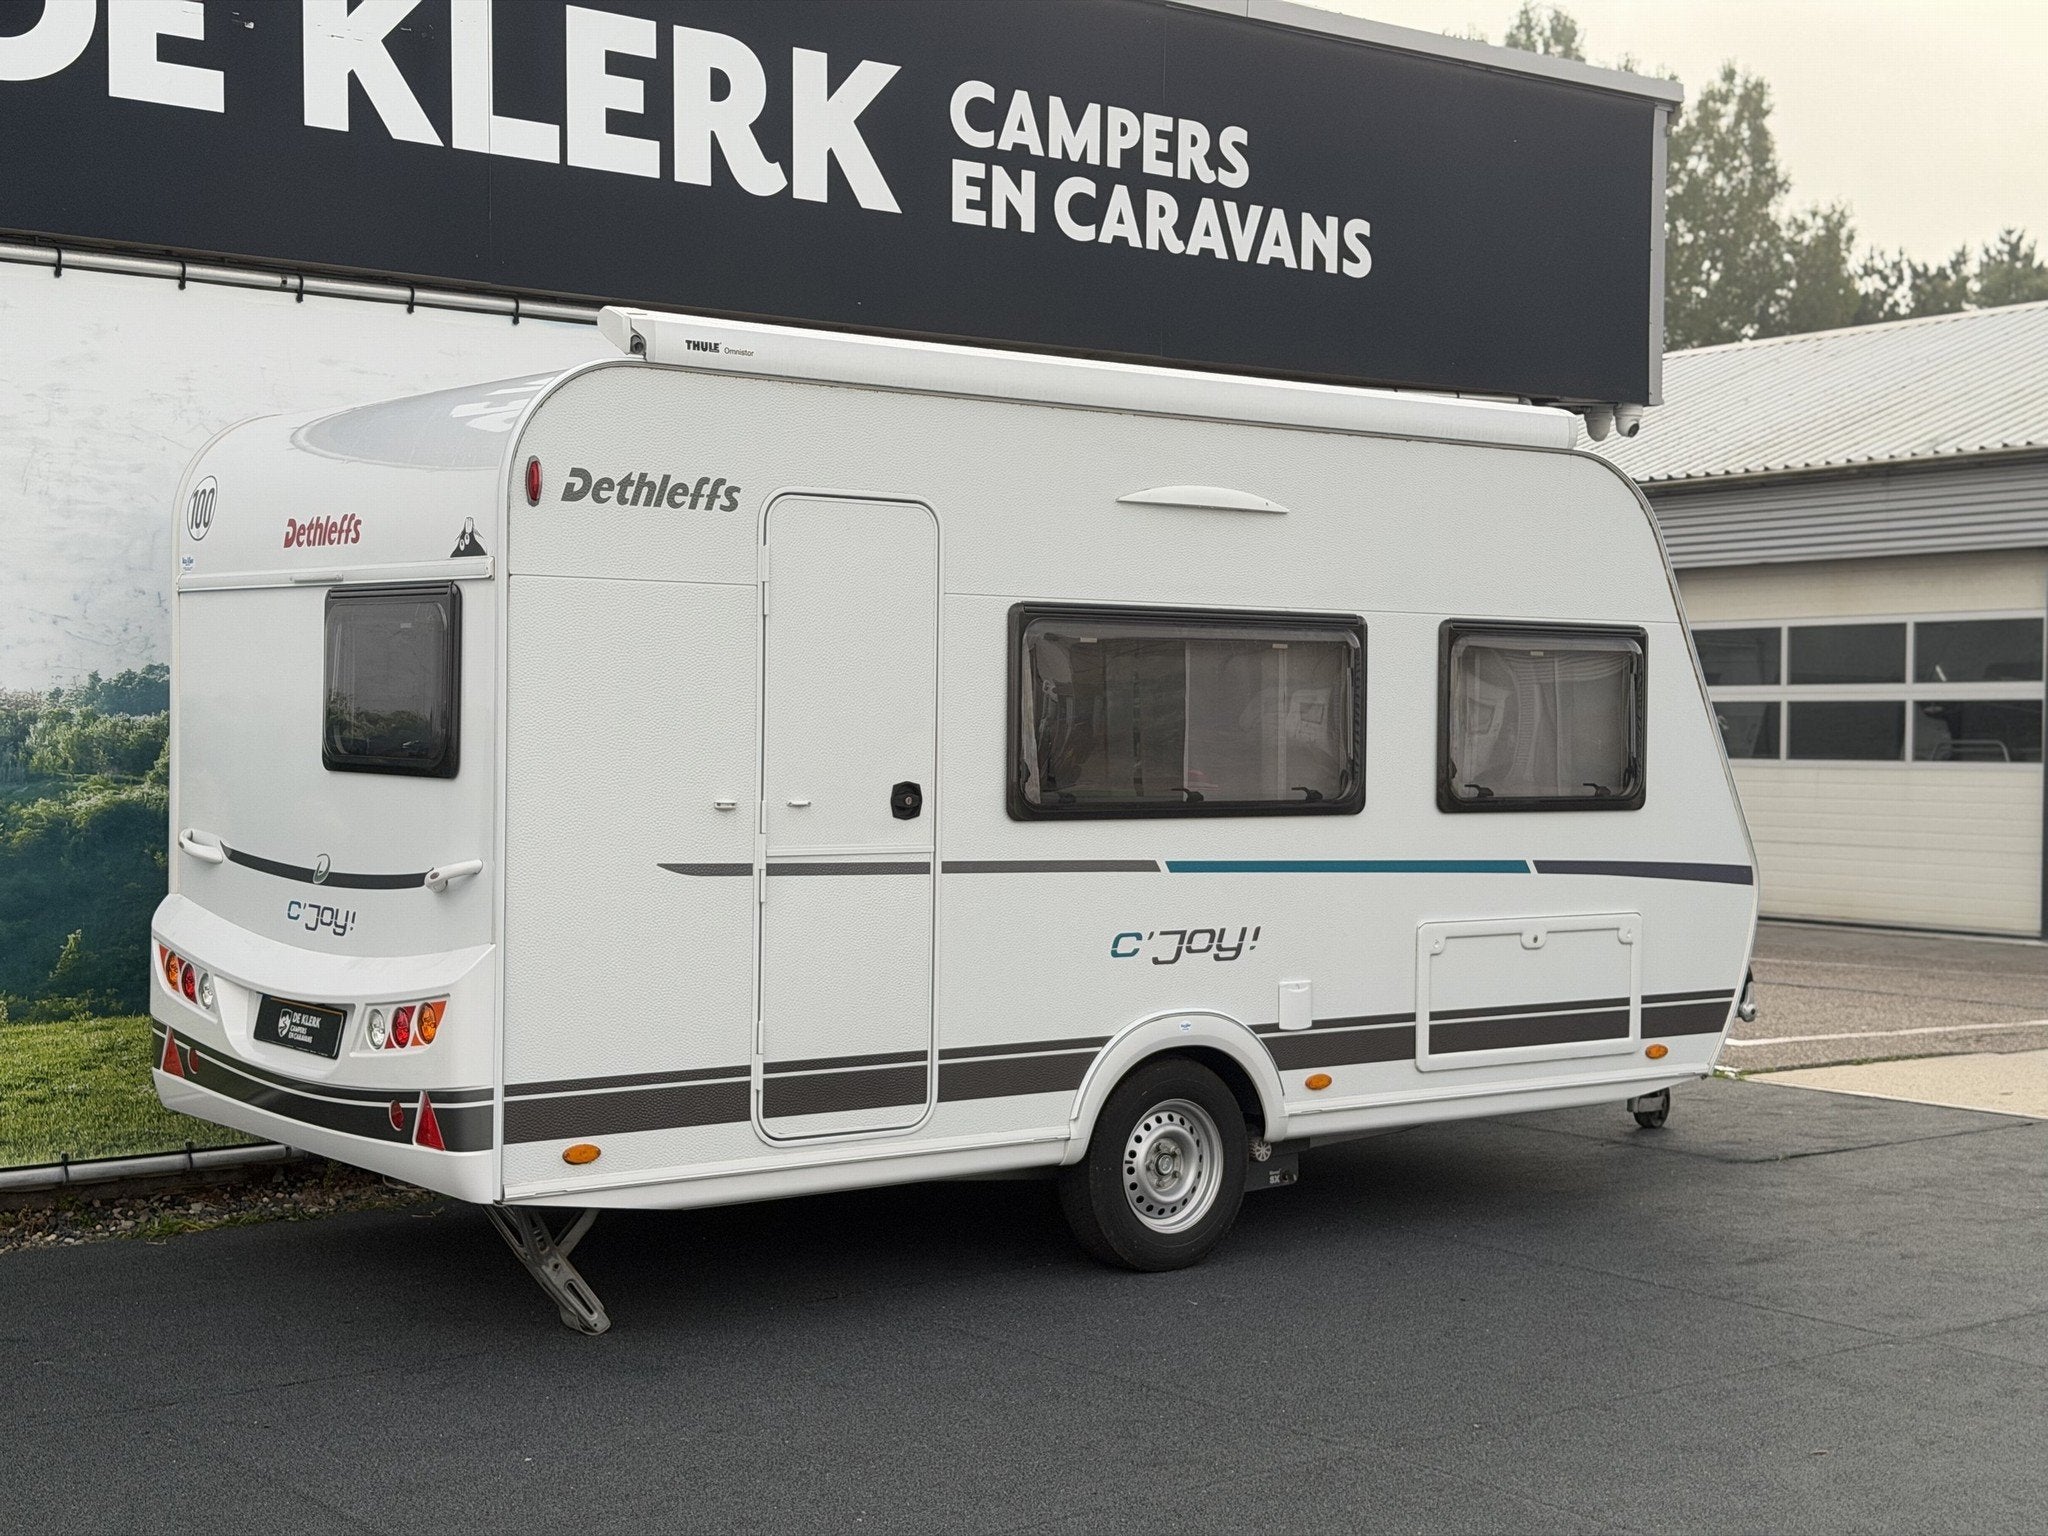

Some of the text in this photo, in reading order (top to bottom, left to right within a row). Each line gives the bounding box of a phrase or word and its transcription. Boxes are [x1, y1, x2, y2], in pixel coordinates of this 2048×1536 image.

[303, 0, 902, 214] KLERK
[950, 80, 1250, 188] CAMPERS
[951, 158, 1373, 279] EN CARAVANS
[685, 339, 754, 357] THULE Omnistor
[191, 488, 215, 529] 100
[561, 467, 741, 512] Dethleffs
[284, 513, 362, 548] Dethleffs
[292, 1012, 322, 1028] DE KLERK
